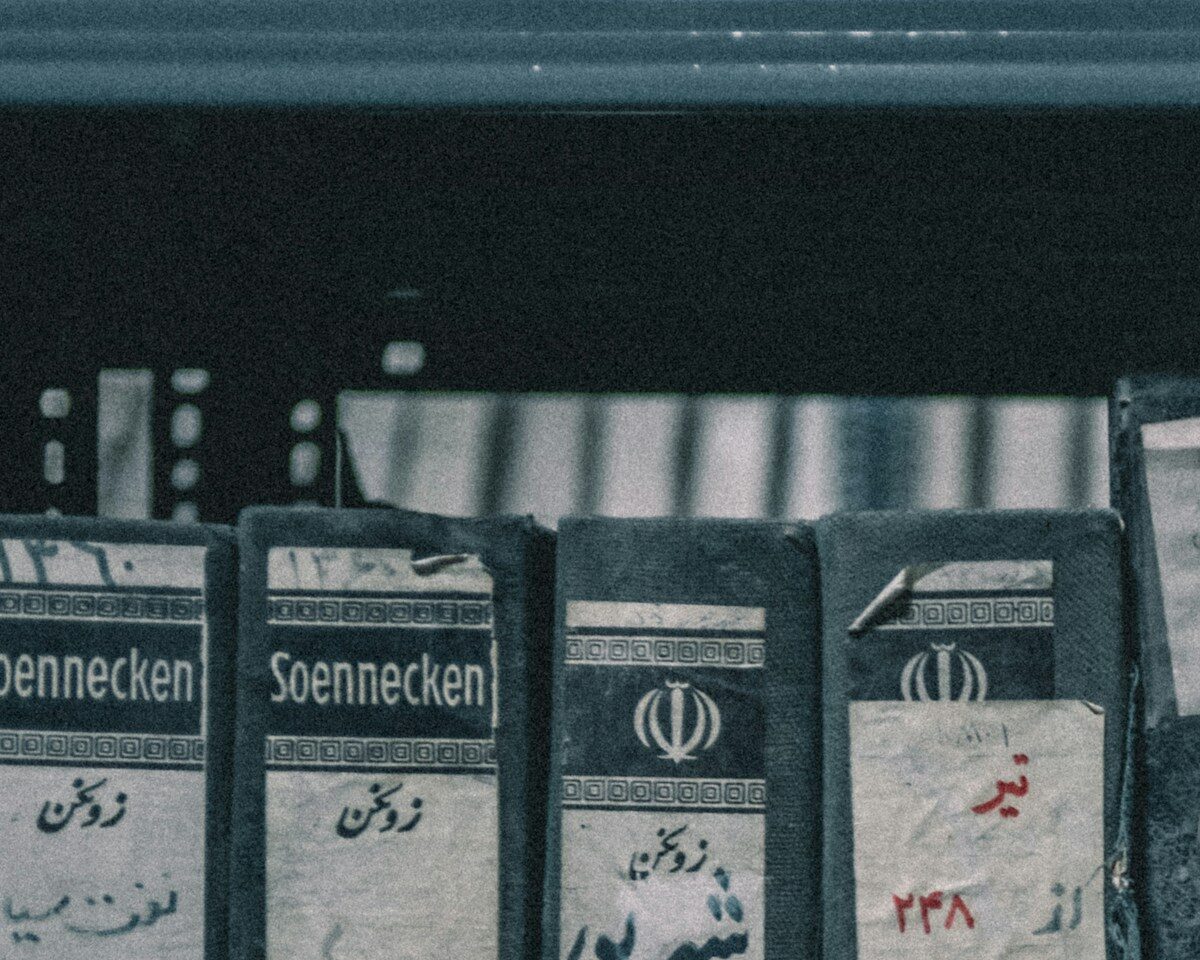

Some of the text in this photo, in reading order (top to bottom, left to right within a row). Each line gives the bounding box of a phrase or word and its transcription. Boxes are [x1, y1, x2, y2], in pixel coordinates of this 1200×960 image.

[271, 651, 485, 707] Soennecken
[37, 778, 128, 834] زونکن
[336, 783, 423, 839] زونکن
